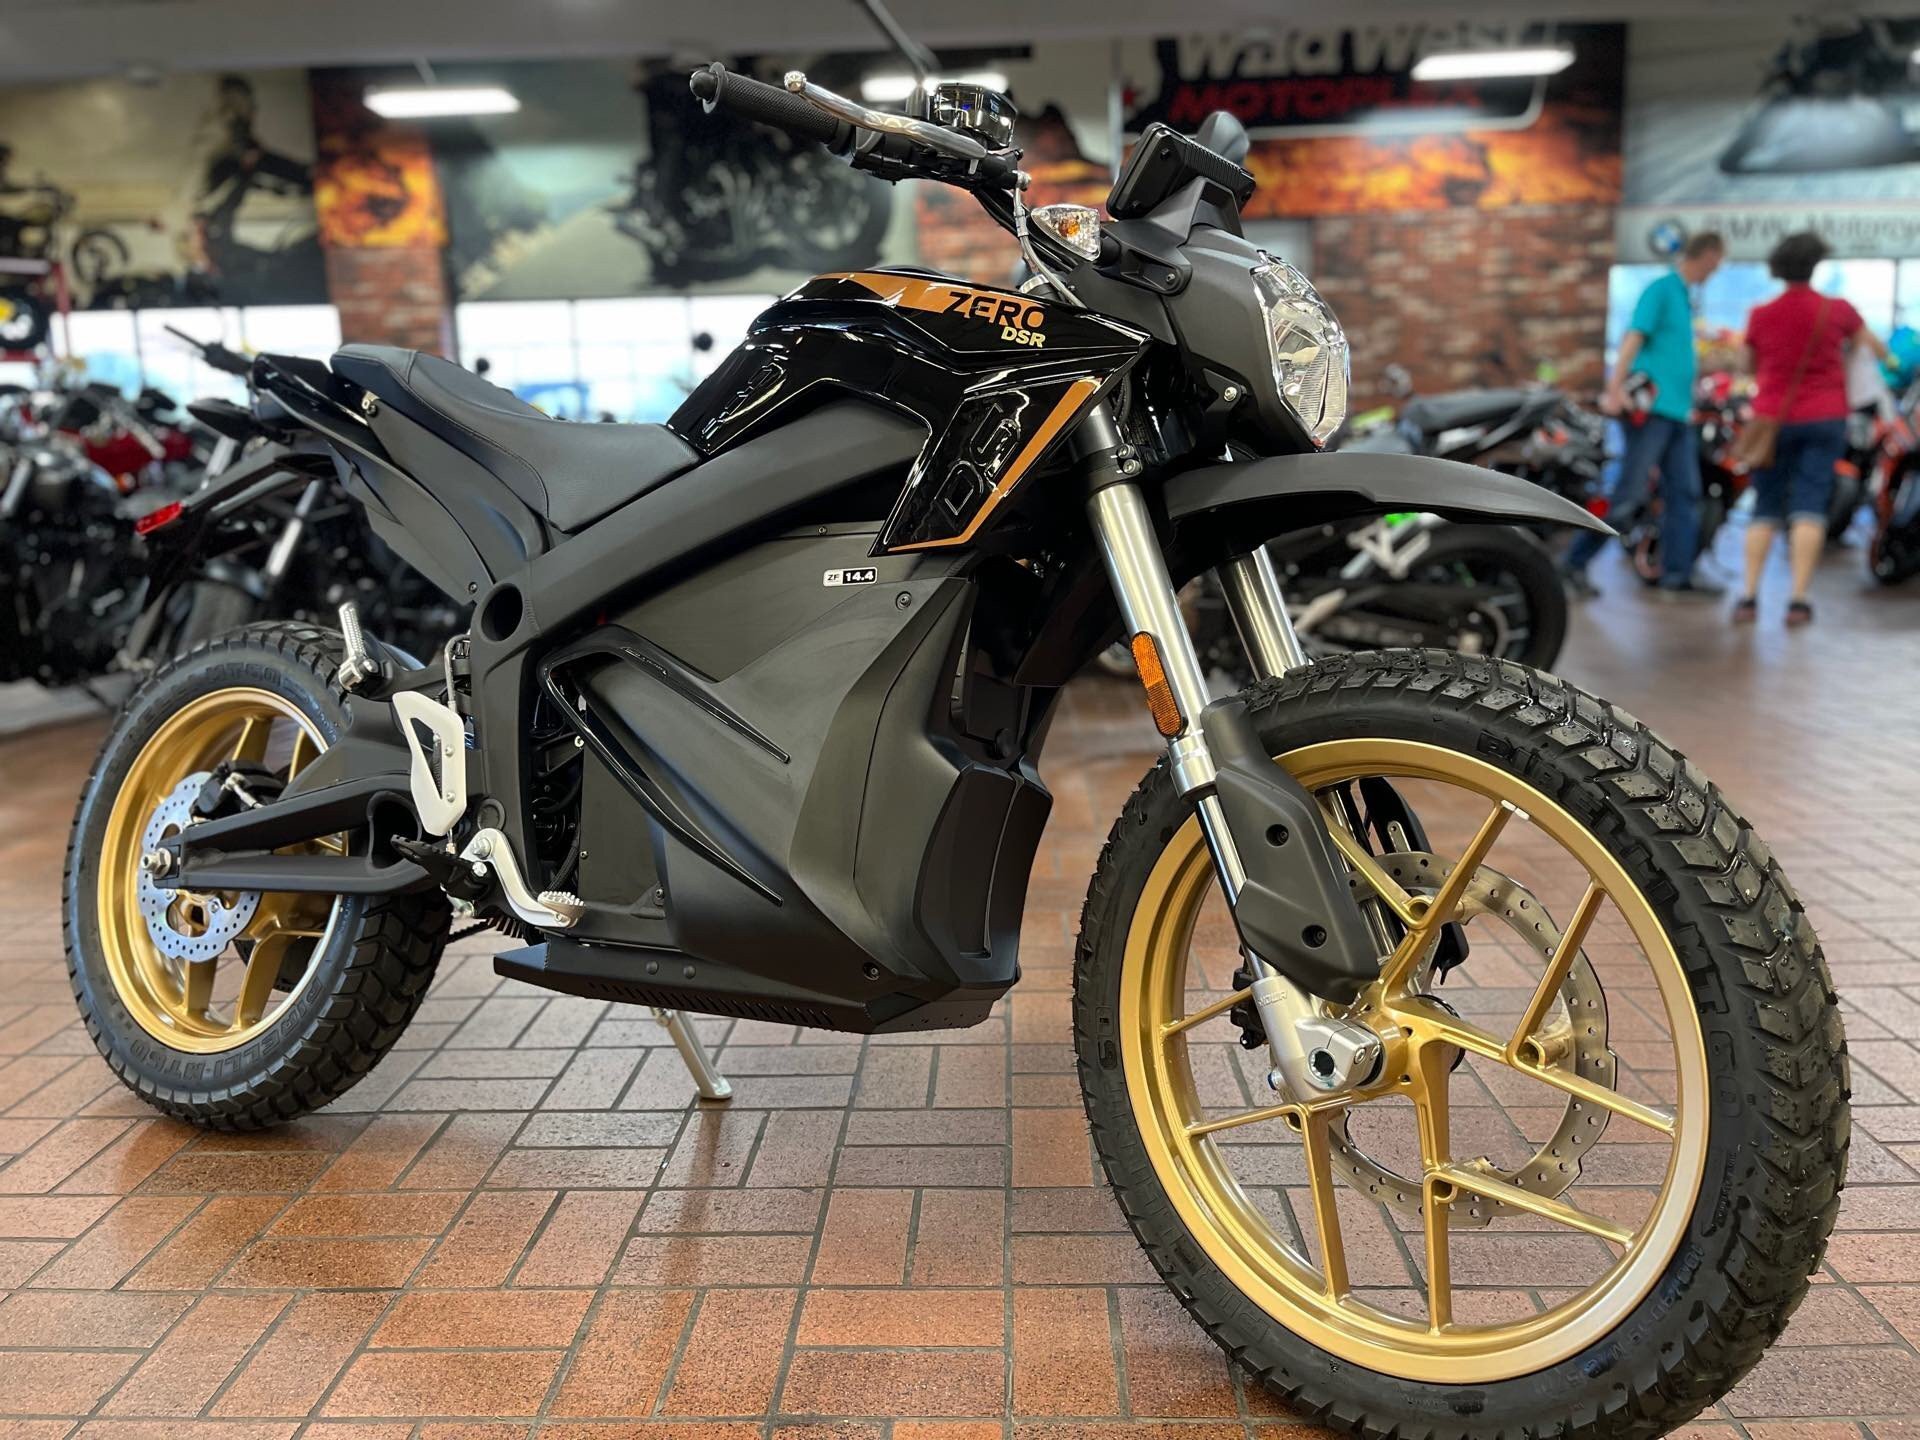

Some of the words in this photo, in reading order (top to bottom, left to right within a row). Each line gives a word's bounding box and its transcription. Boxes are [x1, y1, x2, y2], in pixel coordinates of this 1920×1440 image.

[943, 291, 1047, 330] ZERO
[1001, 326, 1046, 348] DSR
[827, 573, 841, 581] ZF
[845, 570, 874, 582] 14.4
[213, 976, 324, 1080] PIRELLI
